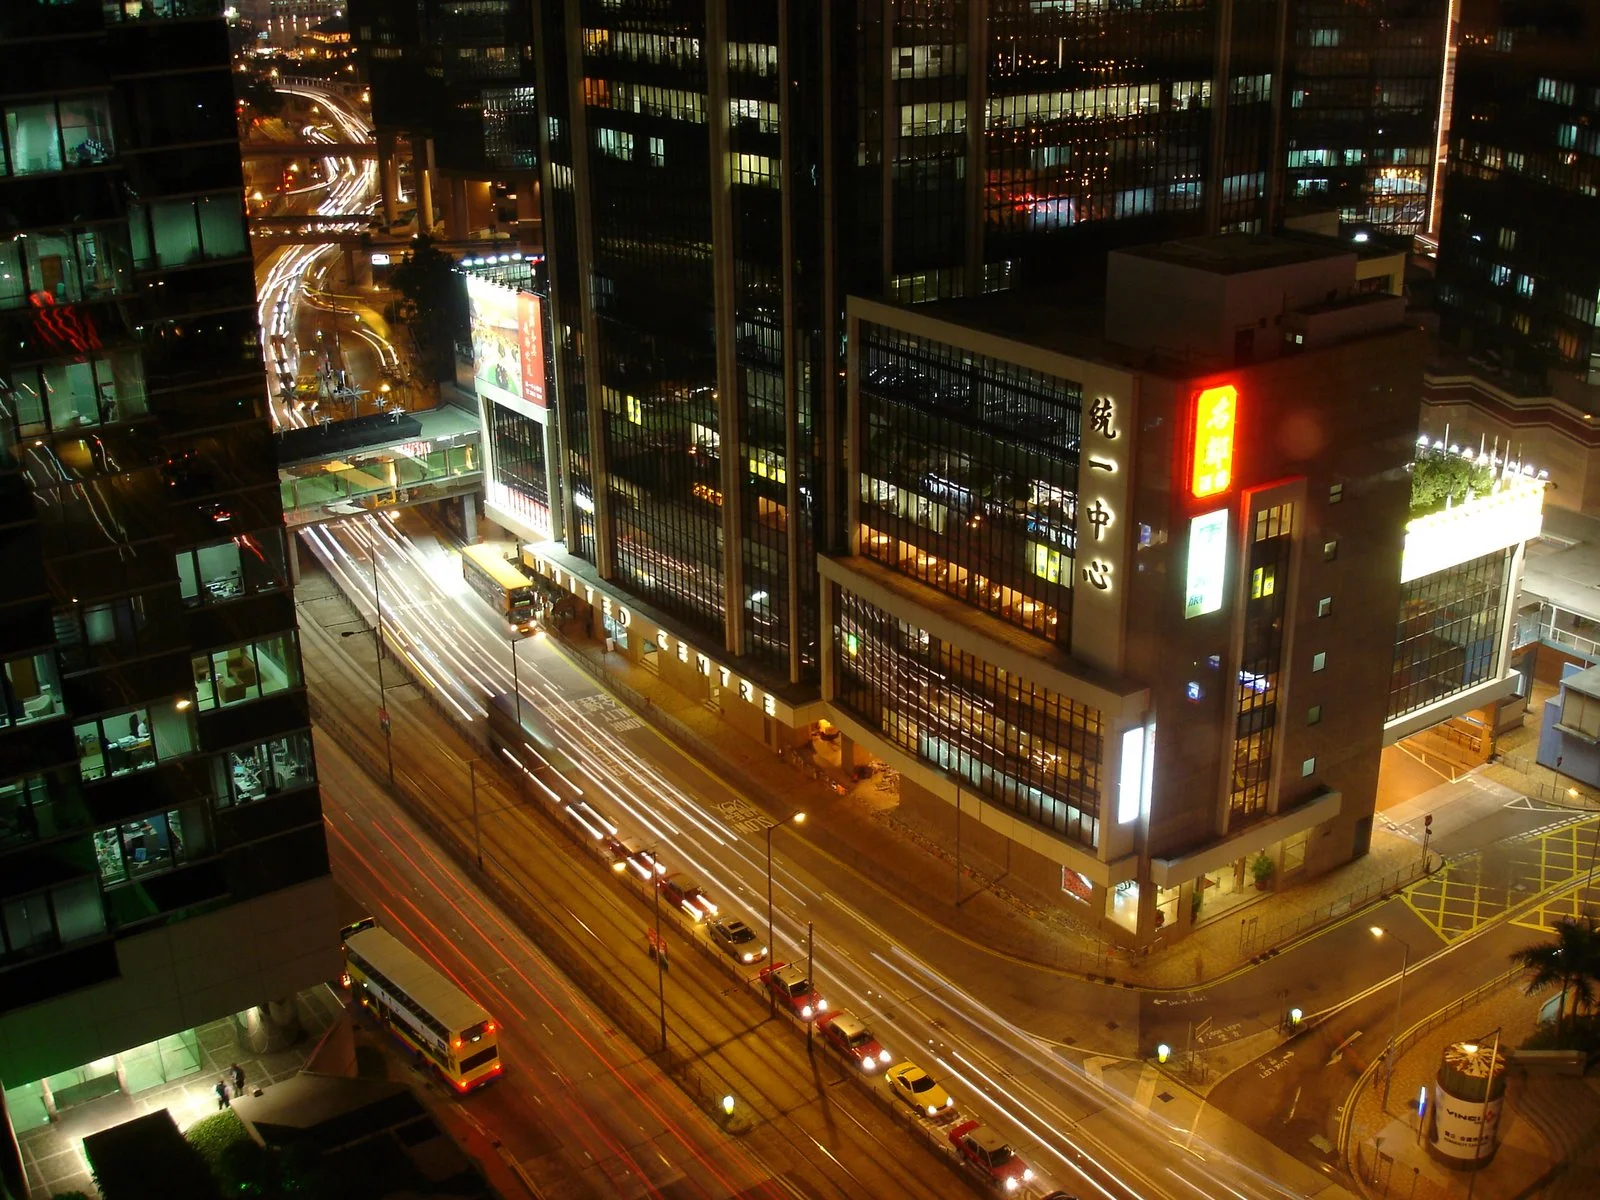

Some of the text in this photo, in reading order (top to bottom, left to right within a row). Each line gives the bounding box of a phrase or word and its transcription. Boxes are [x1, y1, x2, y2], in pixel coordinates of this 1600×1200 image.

[1082, 397, 1118, 592] 統一中心
[534, 556, 777, 717] UNITED CENTRE
